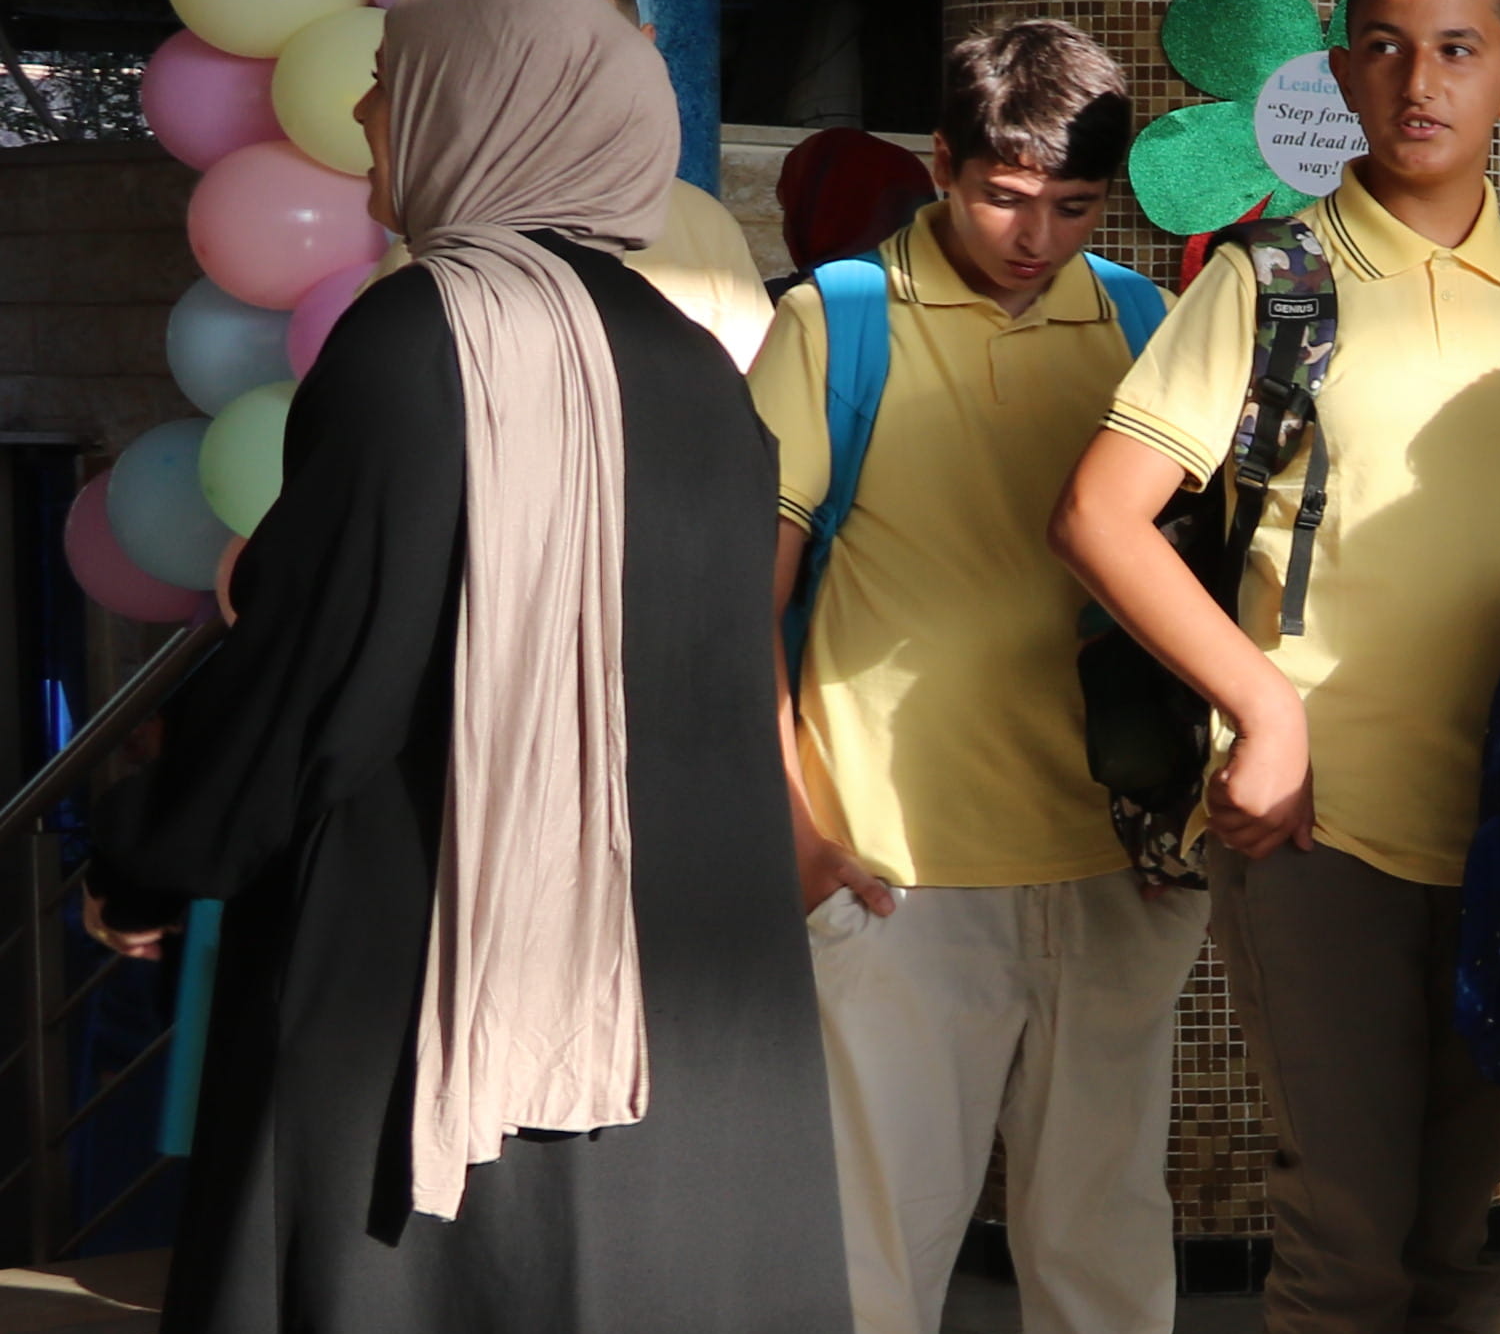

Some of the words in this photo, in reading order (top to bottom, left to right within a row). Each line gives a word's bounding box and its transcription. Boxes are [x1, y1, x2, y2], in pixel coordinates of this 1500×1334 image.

[1278, 75, 1339, 95] Leader
[1315, 107, 1361, 126] forw
[1272, 130, 1307, 146] and
[1310, 132, 1347, 150] lead
[1351, 136, 1369, 151] th
[1298, 161, 1340, 178] way!
[1273, 303, 1314, 314] GENIUS
